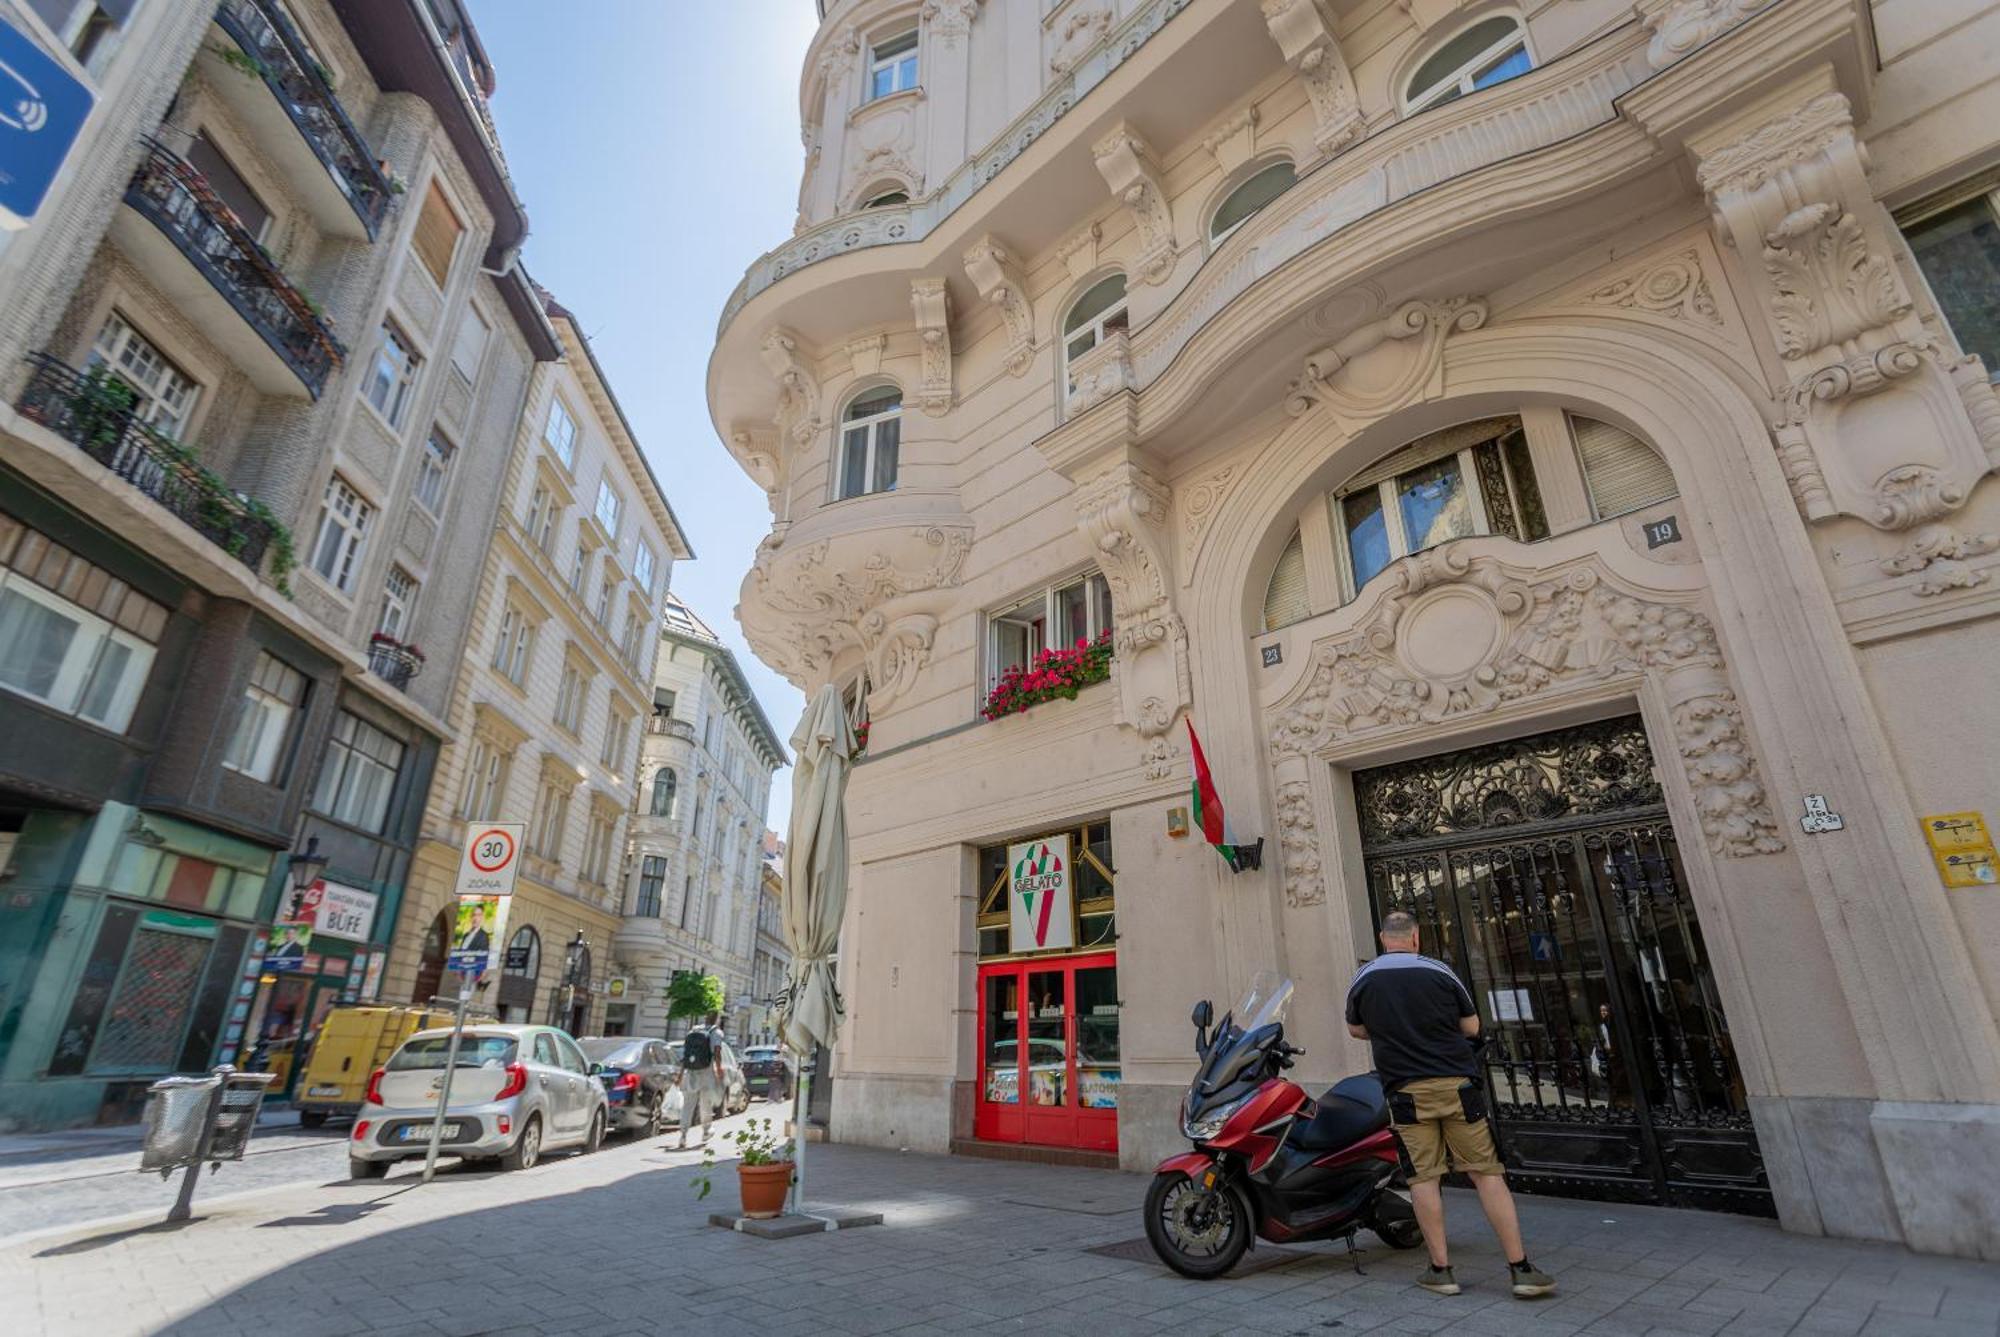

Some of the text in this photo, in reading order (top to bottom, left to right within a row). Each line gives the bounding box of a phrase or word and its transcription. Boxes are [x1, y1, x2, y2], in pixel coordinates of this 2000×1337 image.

[1651, 523, 1672, 542] 19
[1265, 648, 1278, 664] 23
[1810, 799, 1820, 809] Z
[482, 841, 503, 859] 30
[1014, 872, 1062, 895] GELATO
